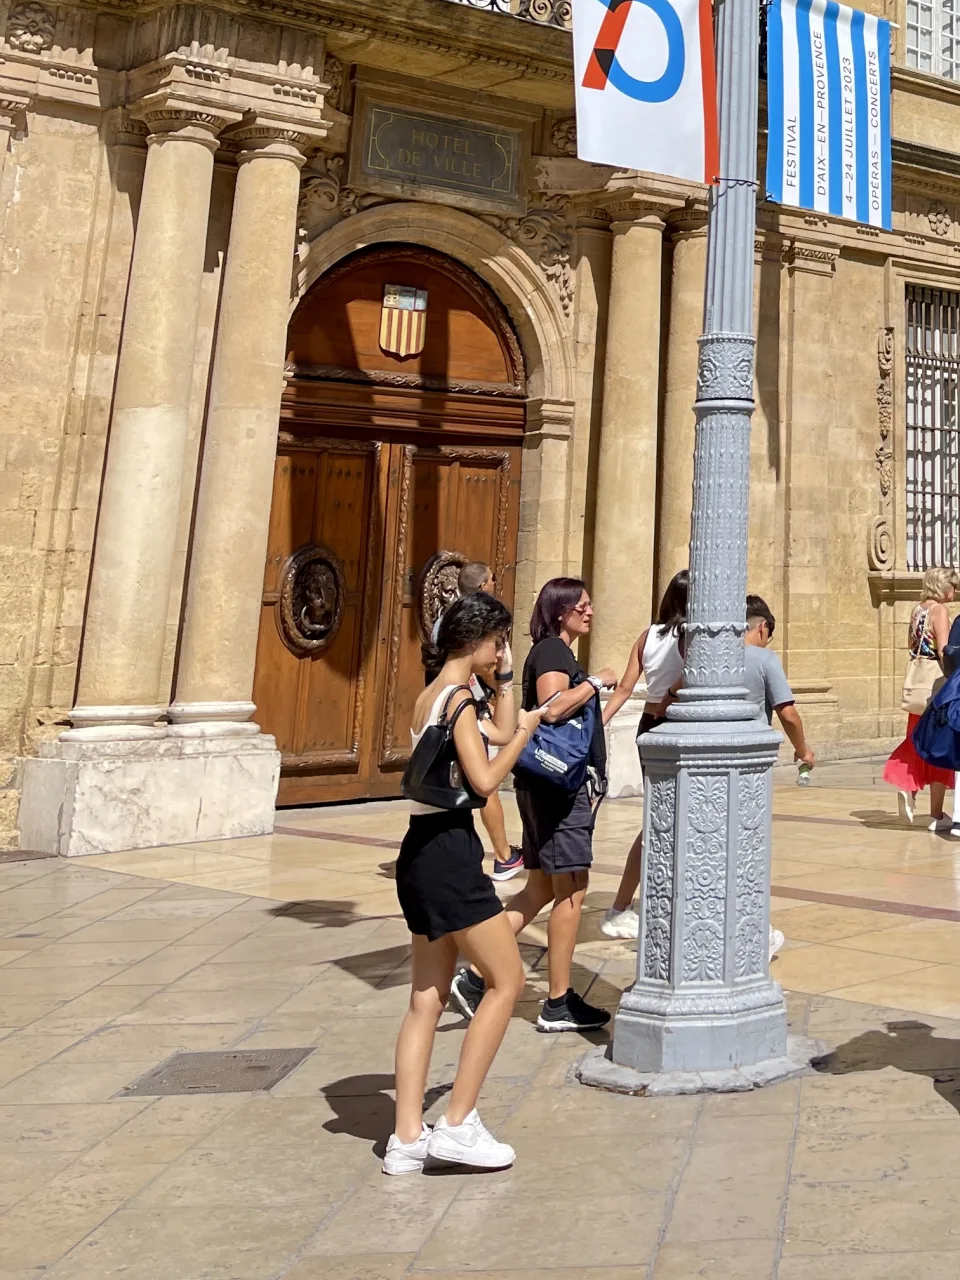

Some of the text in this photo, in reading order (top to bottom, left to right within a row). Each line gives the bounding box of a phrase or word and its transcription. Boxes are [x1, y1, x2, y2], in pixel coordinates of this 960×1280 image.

[842, 57, 853, 94] 2023
[868, 50, 879, 129] CONCERTS
[411, 129, 474, 155] HOTEL
[786, 115, 797, 188] FESTIVAL
[844, 97, 854, 158] JUILLET
[398, 147, 483, 178] DE VILLE
[870, 150, 880, 211] OPÉRAS
